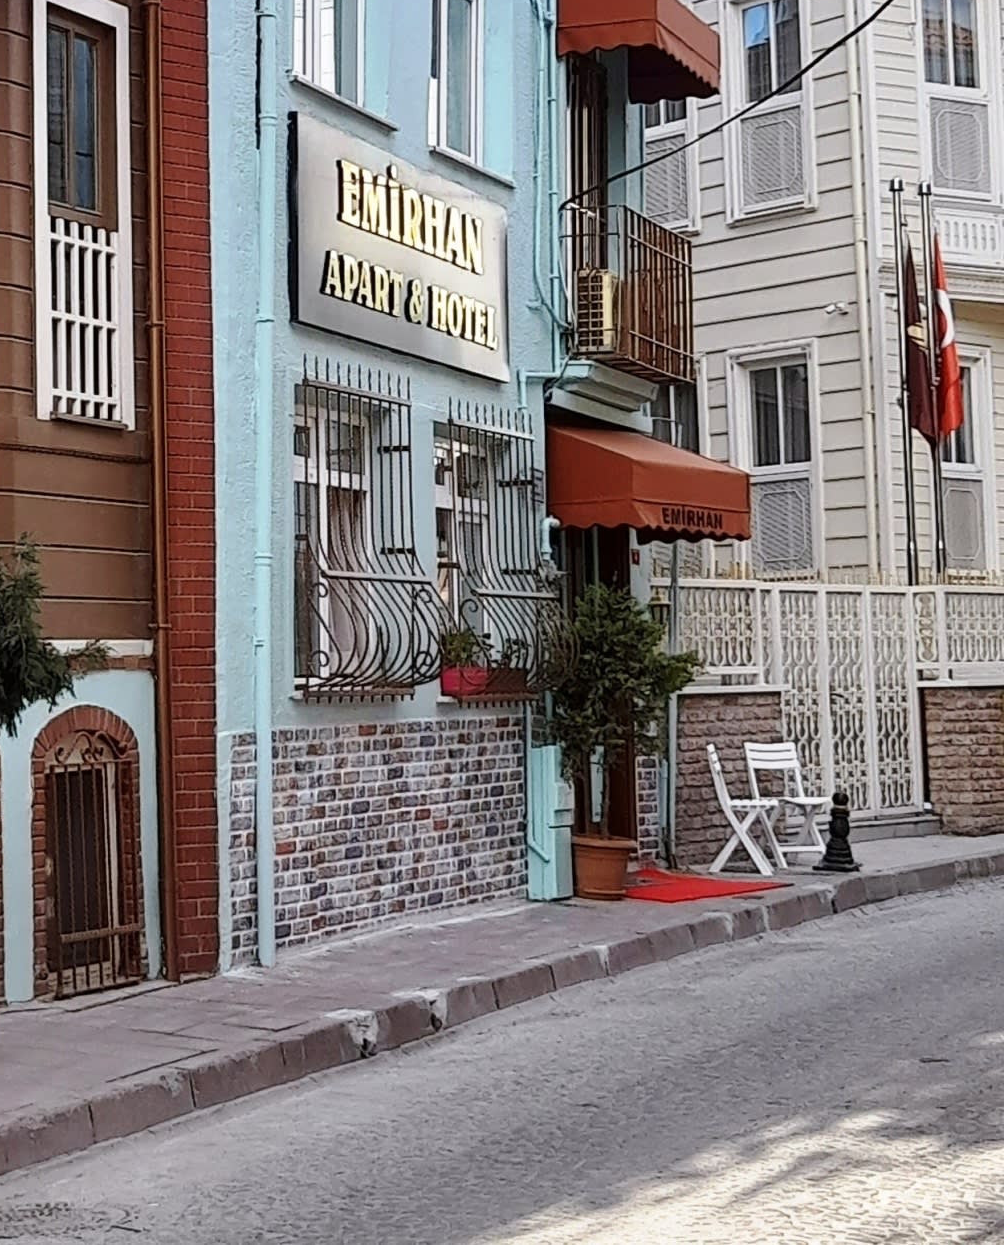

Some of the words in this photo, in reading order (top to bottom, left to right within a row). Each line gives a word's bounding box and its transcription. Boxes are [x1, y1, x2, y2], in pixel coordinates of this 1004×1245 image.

[337, 160, 484, 275] EMİRHAN
[321, 250, 404, 317] APART
[405, 279, 424, 324] &
[428, 285, 498, 351] HOTEL
